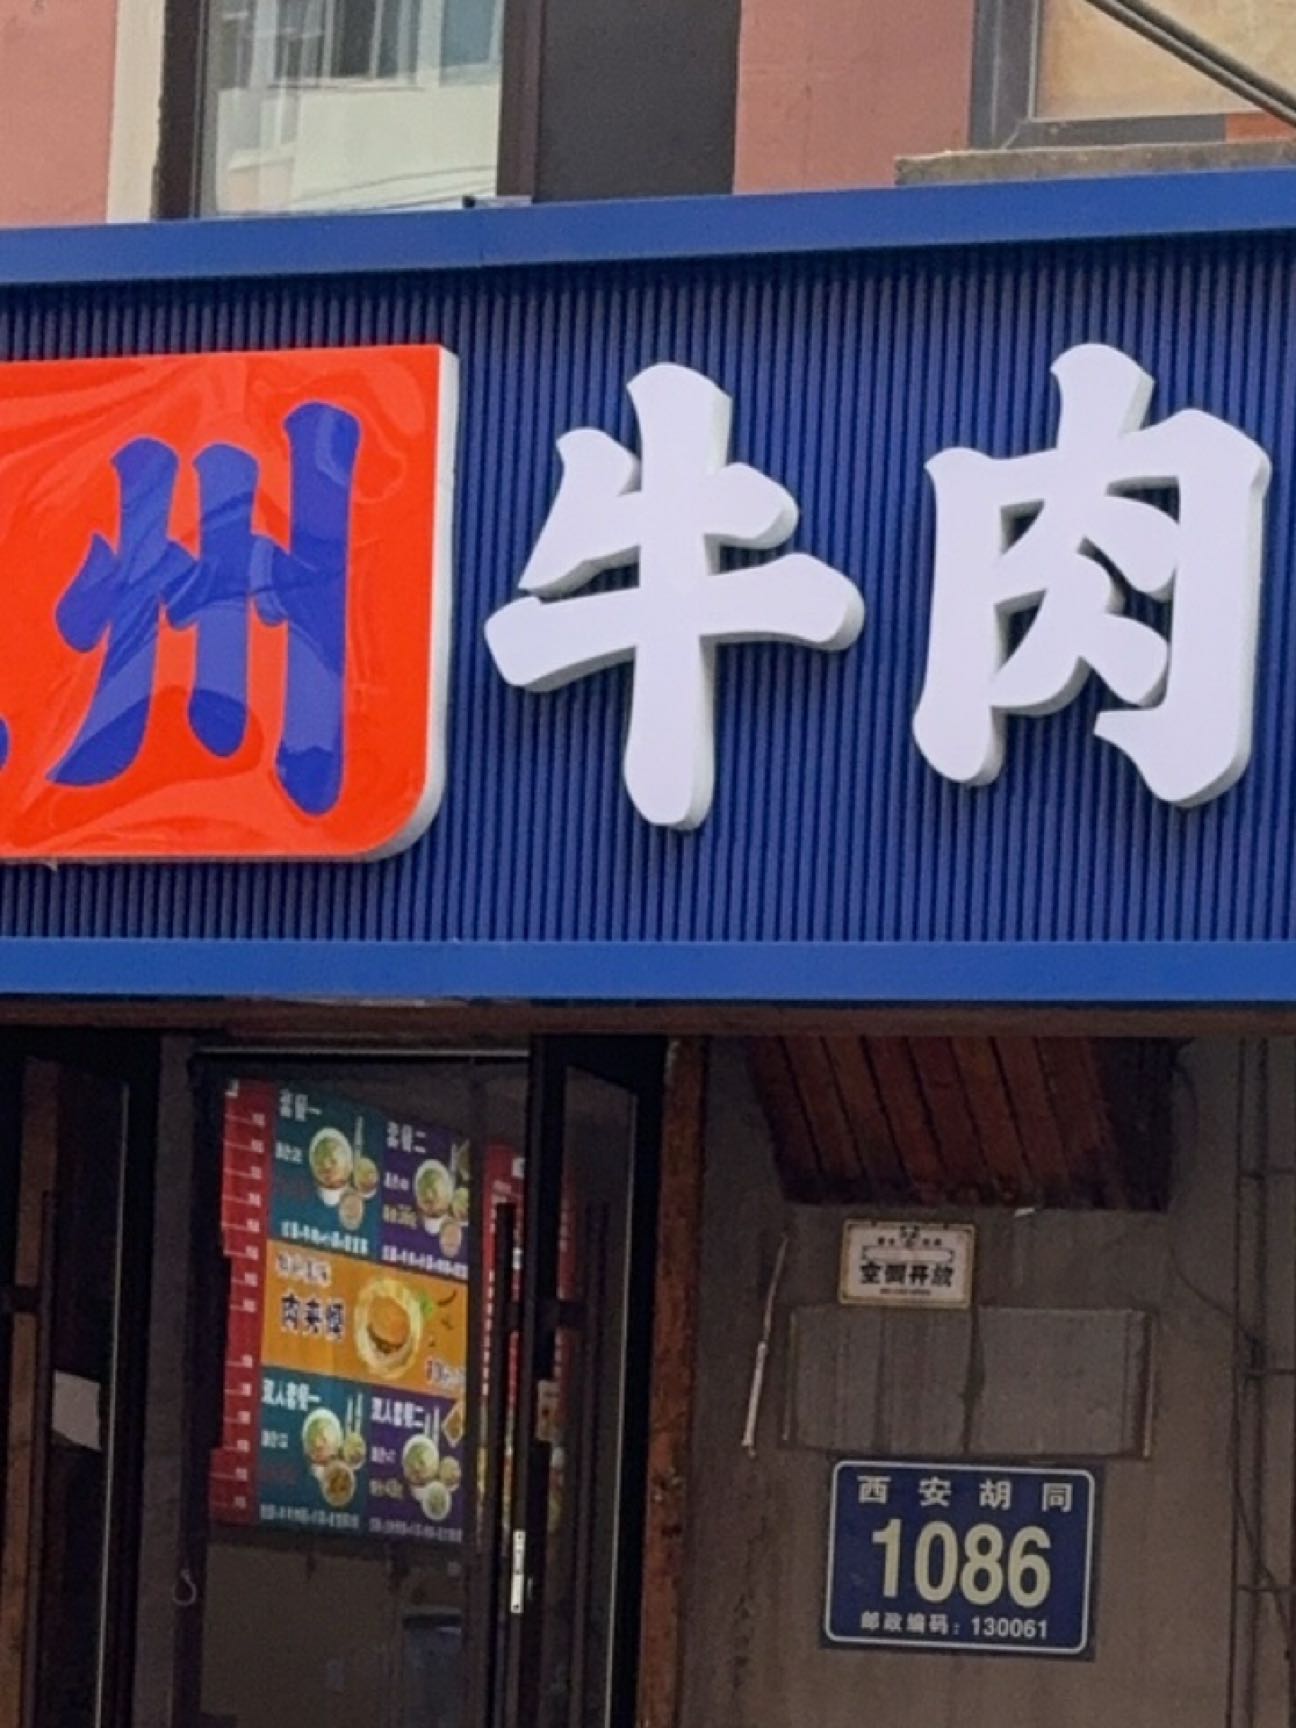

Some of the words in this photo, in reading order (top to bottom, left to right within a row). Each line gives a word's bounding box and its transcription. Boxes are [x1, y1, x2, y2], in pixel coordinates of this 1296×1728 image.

[0, 402, 362, 816] 州
[857, 1475, 1073, 1512] 西安胡同
[872, 1518, 1051, 1608] 1086
